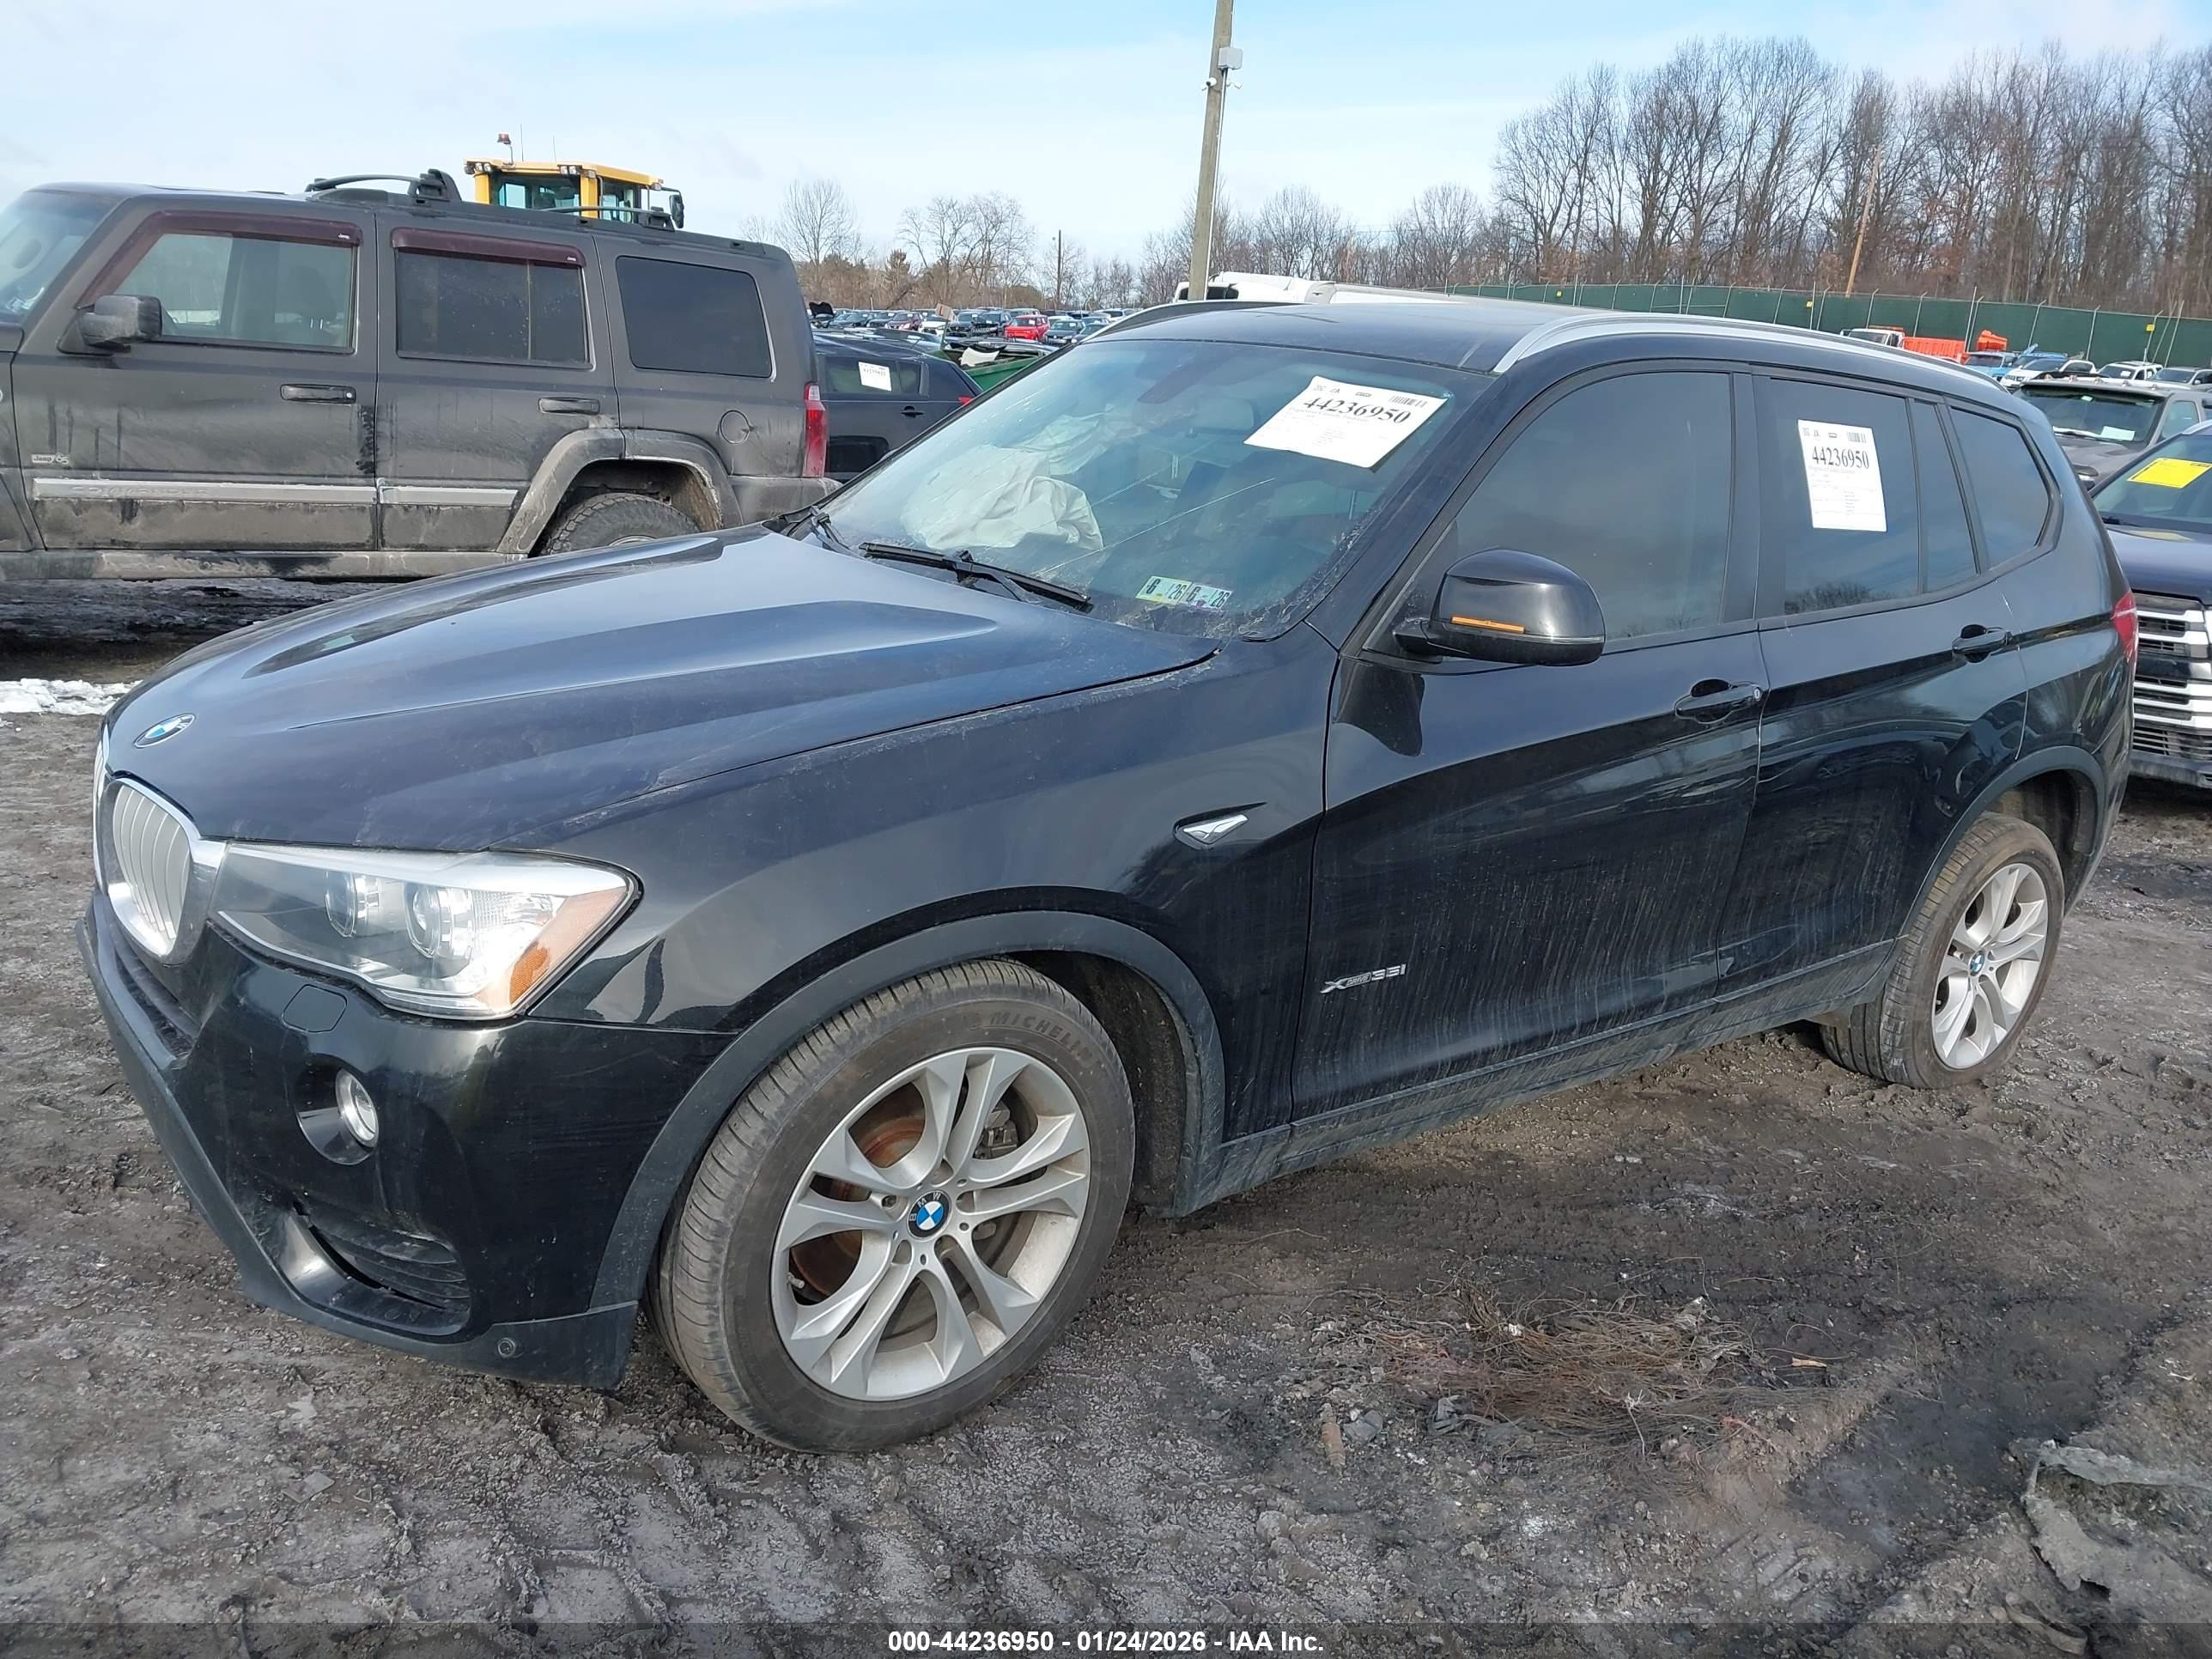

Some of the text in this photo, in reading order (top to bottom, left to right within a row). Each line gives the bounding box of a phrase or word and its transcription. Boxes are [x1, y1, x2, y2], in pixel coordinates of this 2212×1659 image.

[1304, 397, 1411, 424] 44236950
[1812, 446, 1869, 469] 44236950
[1168, 584, 1187, 600] 26
[1210, 591, 1230, 608] 26
[990, 1012, 1094, 1061] MICHELIN
[908, 1192, 941, 1222] BMW
